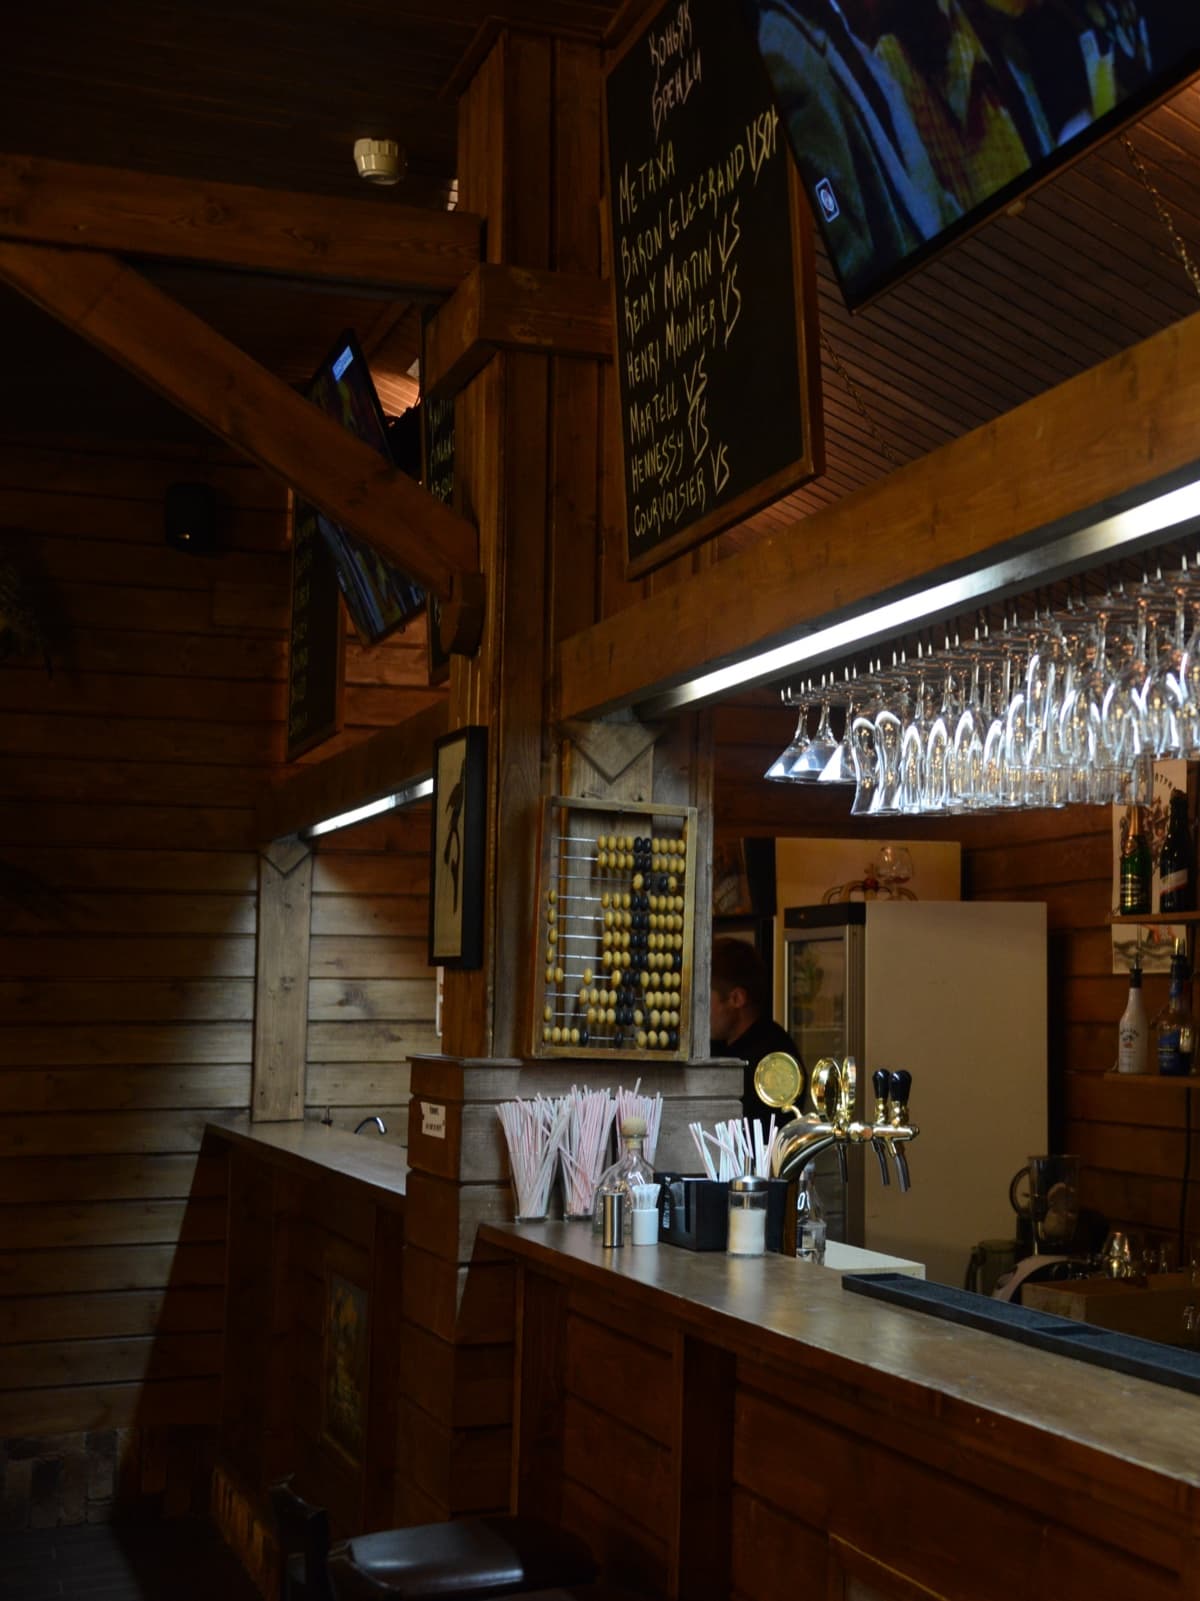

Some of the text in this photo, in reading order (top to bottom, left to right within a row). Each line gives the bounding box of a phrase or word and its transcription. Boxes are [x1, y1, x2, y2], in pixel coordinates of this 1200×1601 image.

[618, 139, 676, 225] METAXA
[620, 210, 663, 289] BARON
[624, 195, 741, 345] REMY MARTIN VS
[626, 262, 742, 390] HENRI MOUNIER VS
[629, 345, 709, 445] MARTELL VS
[631, 397, 710, 494] HENNESSY VS
[633, 440, 730, 537] COURVOISIER VS
